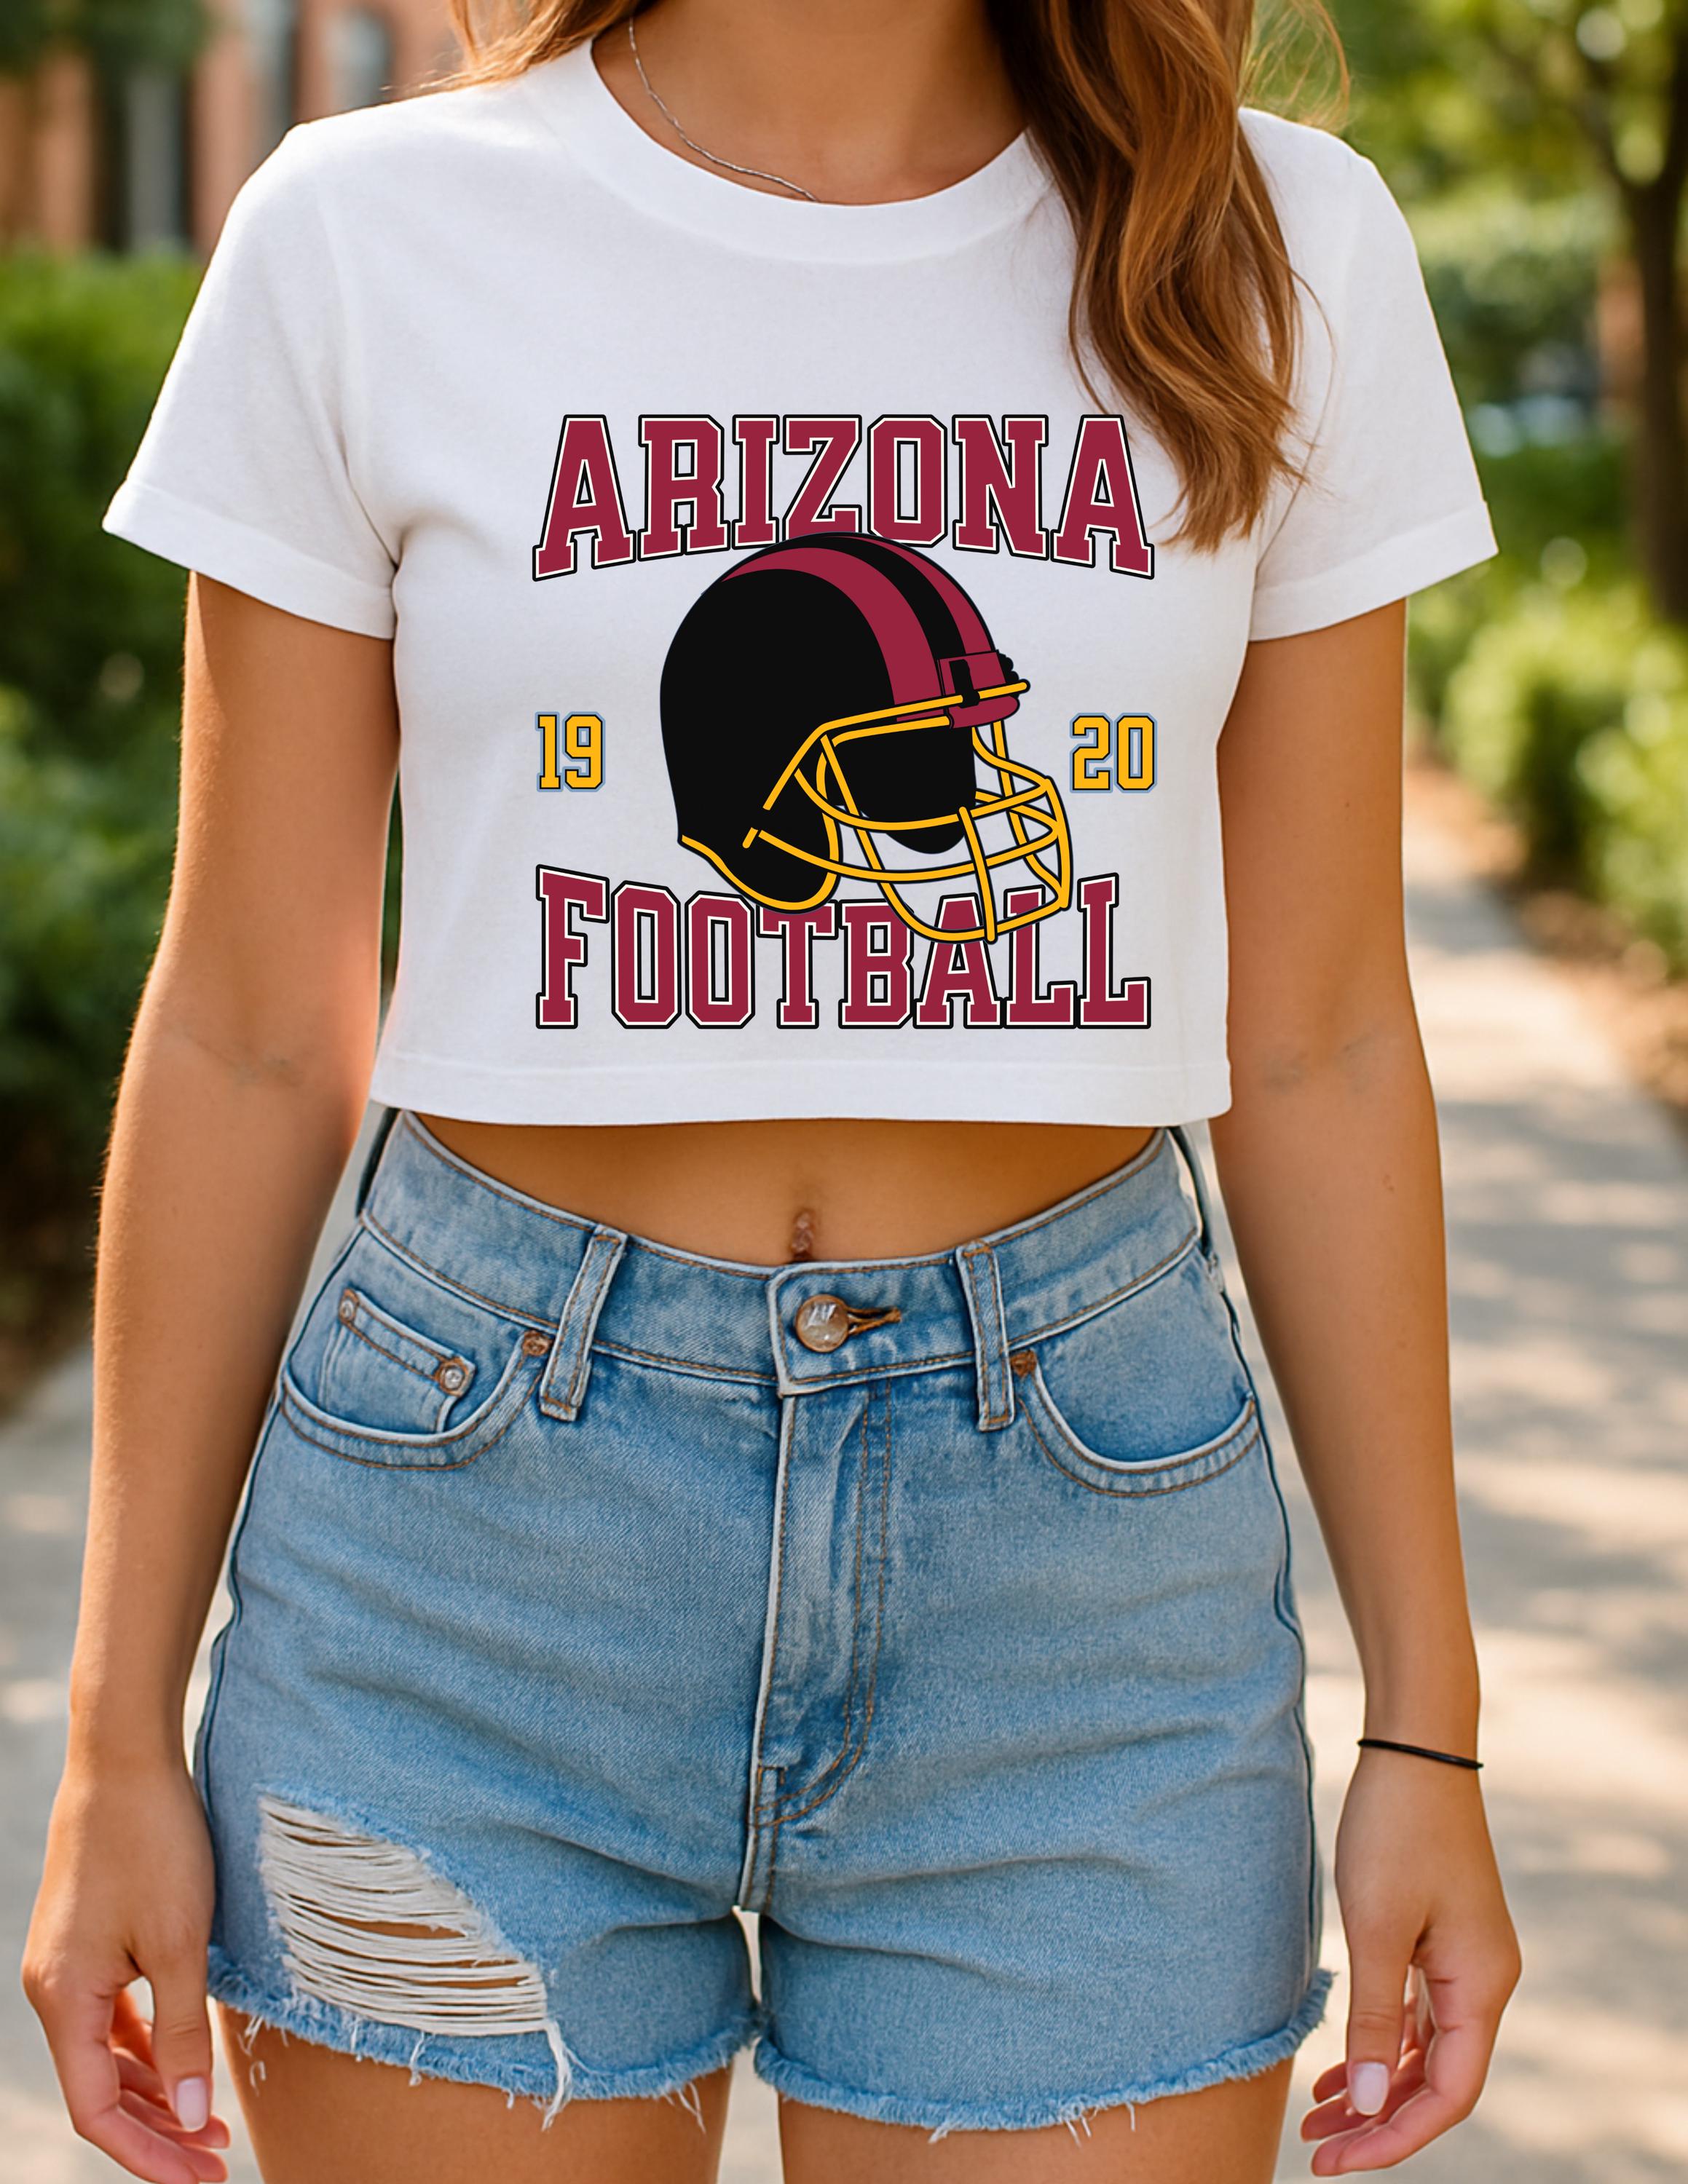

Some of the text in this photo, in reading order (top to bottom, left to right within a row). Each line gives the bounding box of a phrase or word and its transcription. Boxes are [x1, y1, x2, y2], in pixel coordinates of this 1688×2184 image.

[532, 414, 1154, 581] ARIZONA
[536, 712, 1157, 793] 19 20
[536, 864, 1151, 1029] FOOTBALL
